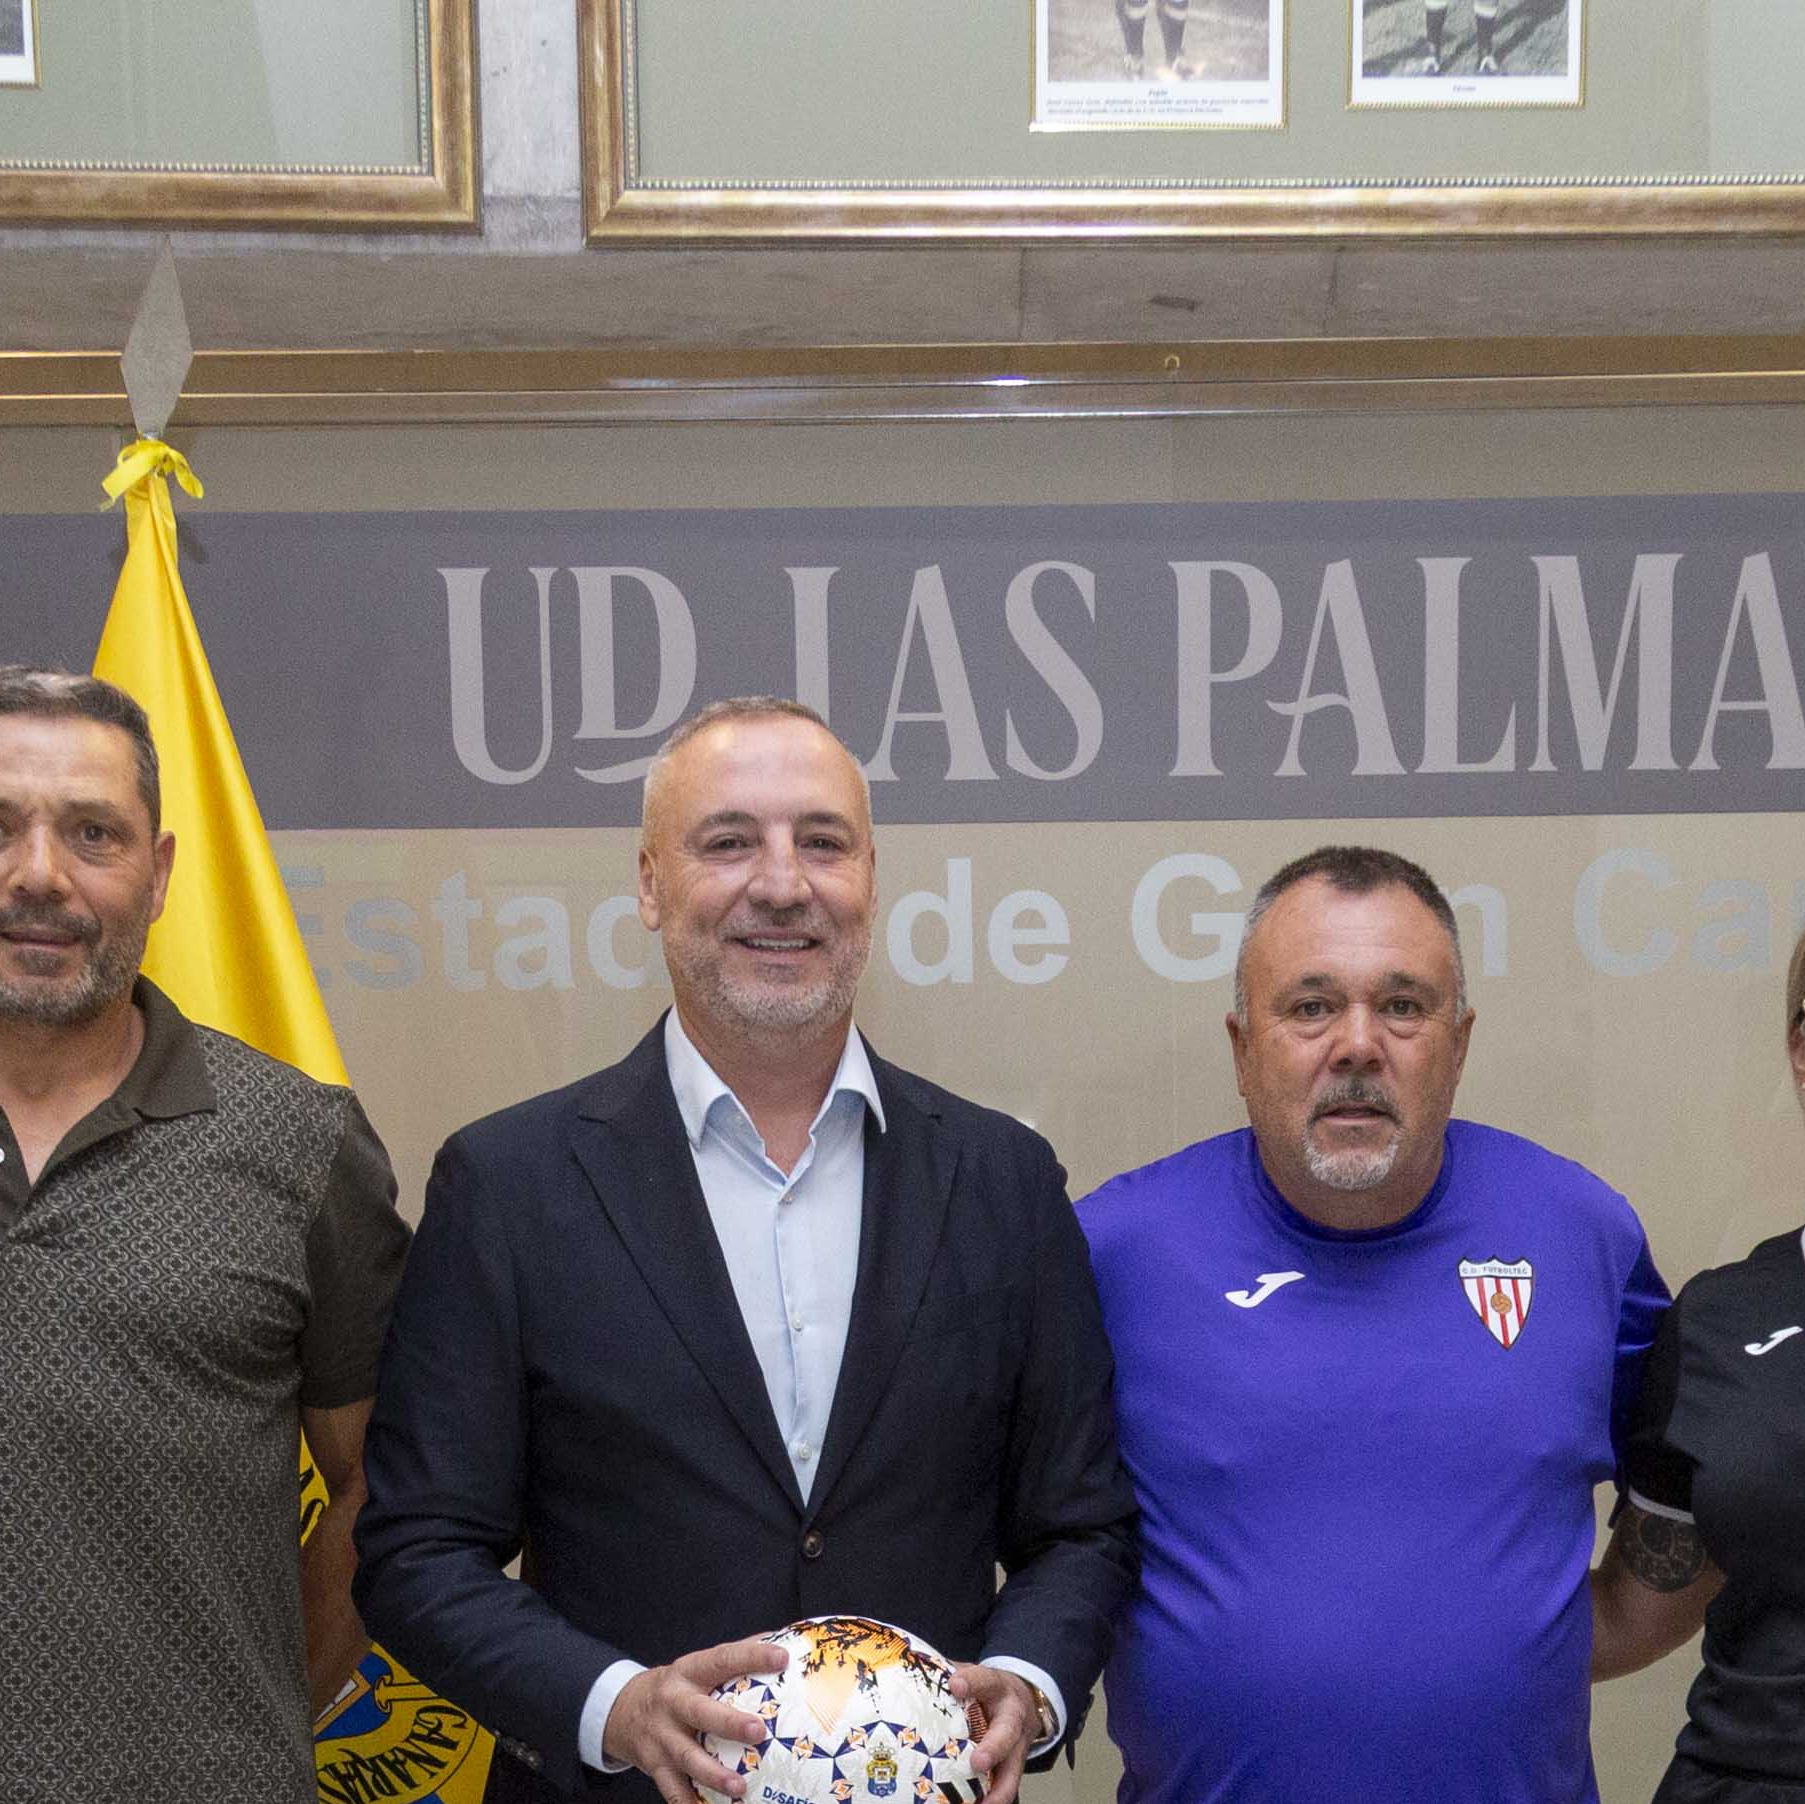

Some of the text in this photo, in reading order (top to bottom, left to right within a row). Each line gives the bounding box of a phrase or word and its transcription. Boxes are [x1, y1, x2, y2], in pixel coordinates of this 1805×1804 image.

[436, 566, 696, 785] UD
[784, 560, 1104, 782] LAS
[886, 857, 1070, 986] de
